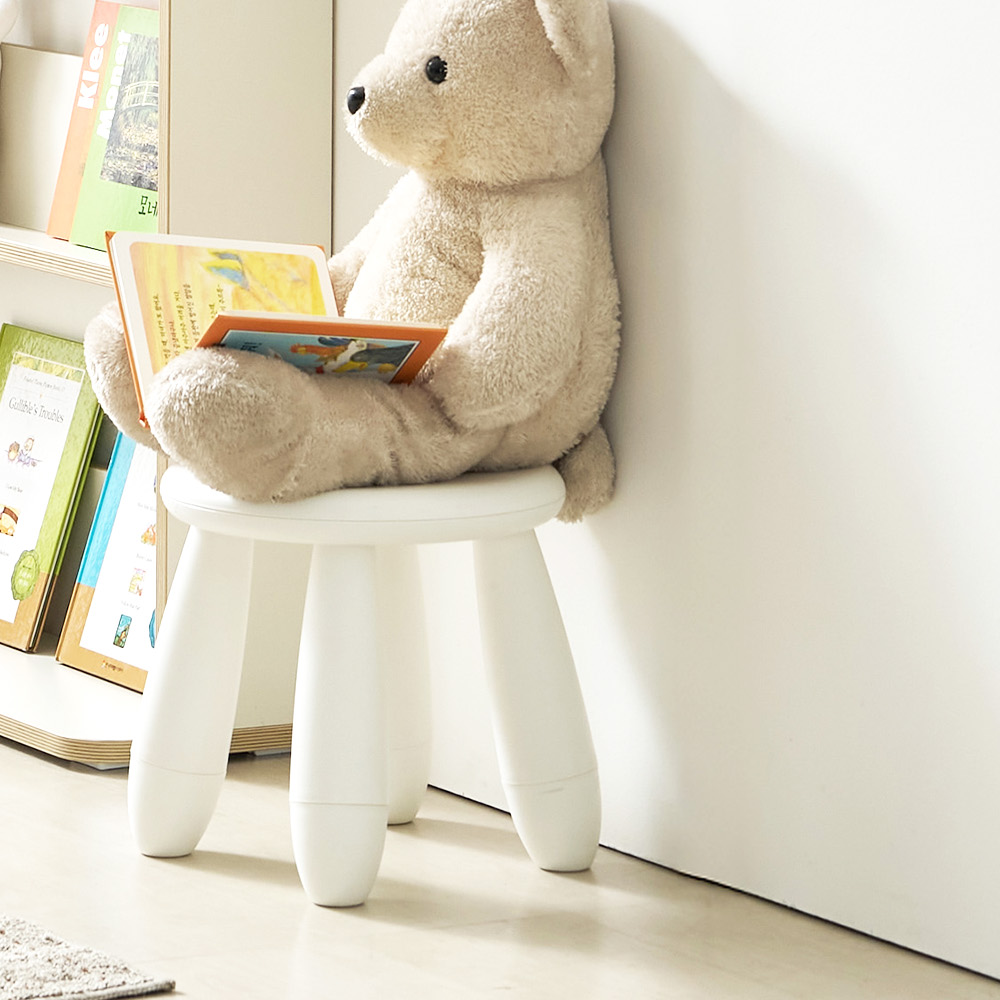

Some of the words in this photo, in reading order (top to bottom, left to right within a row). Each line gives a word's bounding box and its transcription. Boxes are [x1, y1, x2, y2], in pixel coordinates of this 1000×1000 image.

[77, 23, 109, 109] Klee
[97, 29, 132, 140] Monet
[9, 397, 39, 416] Gullible's
[39, 405, 64, 423] Troubles
